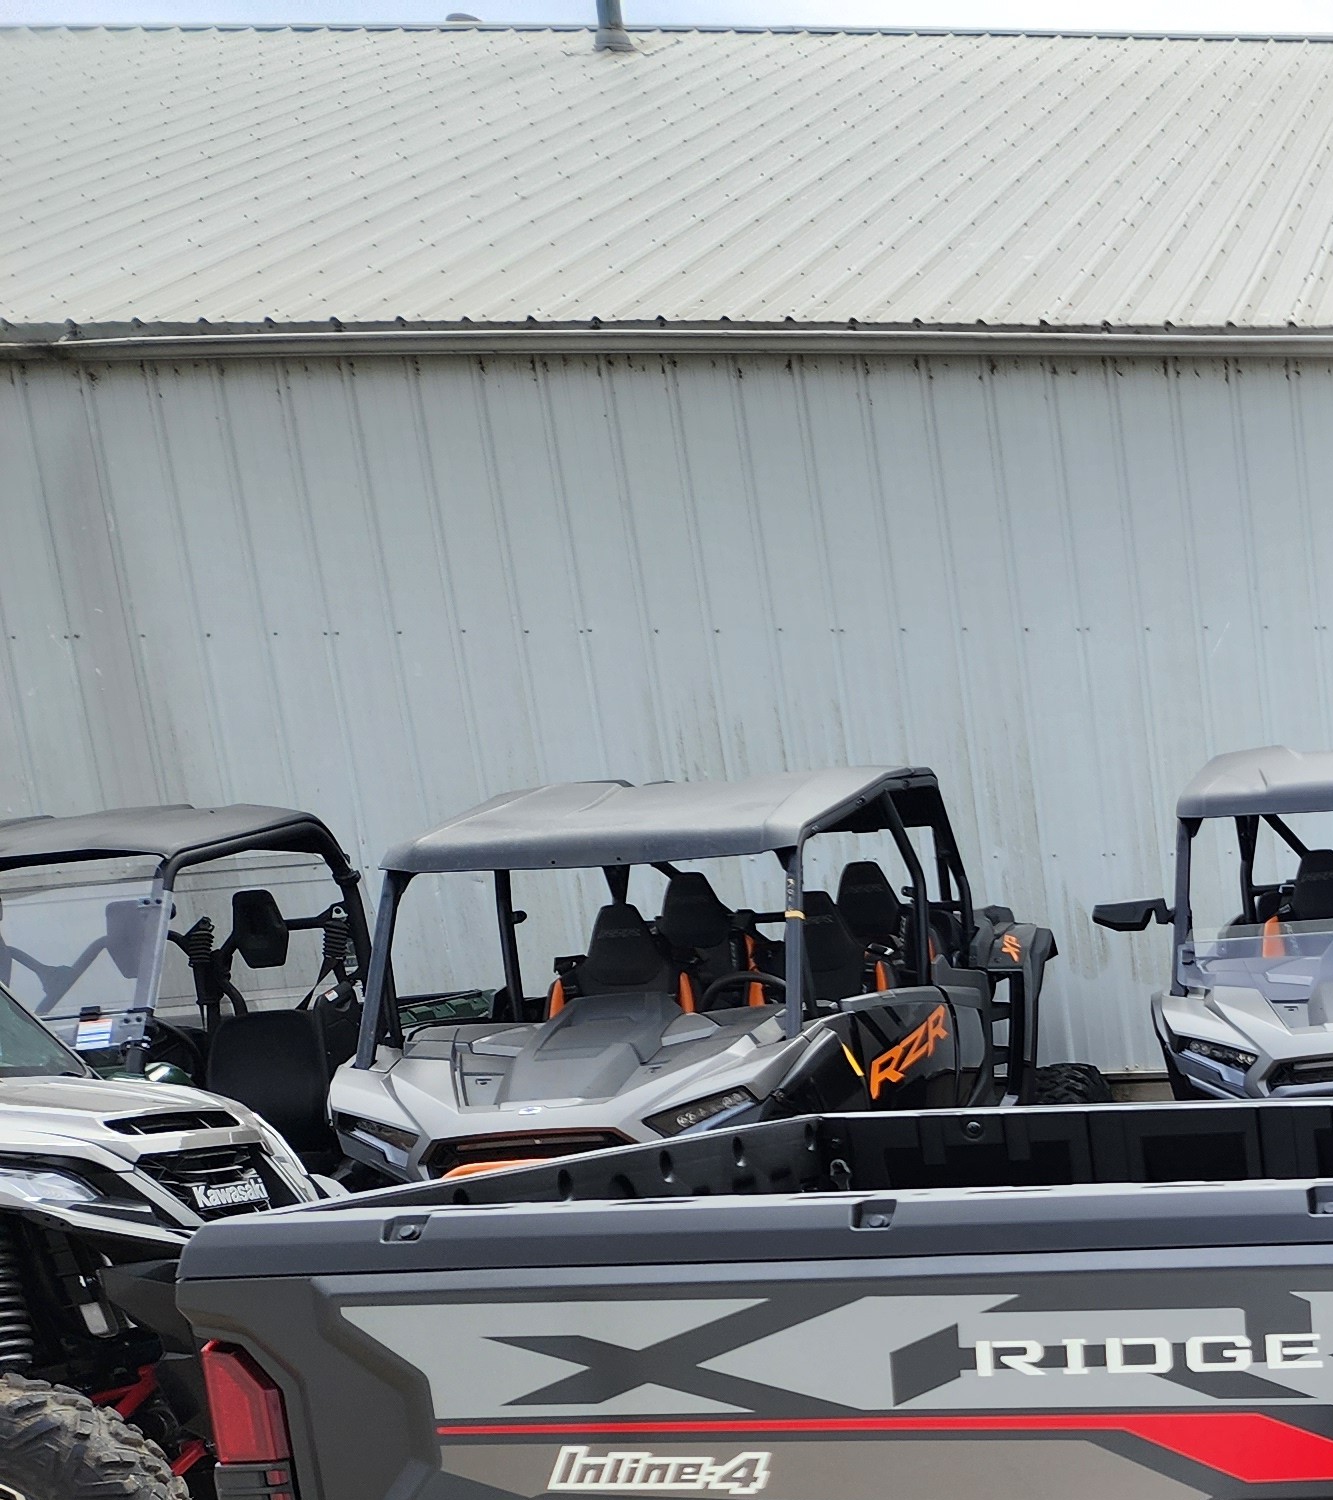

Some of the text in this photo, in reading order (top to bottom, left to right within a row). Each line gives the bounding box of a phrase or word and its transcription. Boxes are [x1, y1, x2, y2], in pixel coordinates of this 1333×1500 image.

[1002, 934, 1021, 963] XP
[869, 1004, 949, 1101] RZR
[192, 1178, 268, 1209] Kawasaki
[975, 1331, 1324, 1377] RIDGE
[547, 1445, 771, 1495] Inline-4
